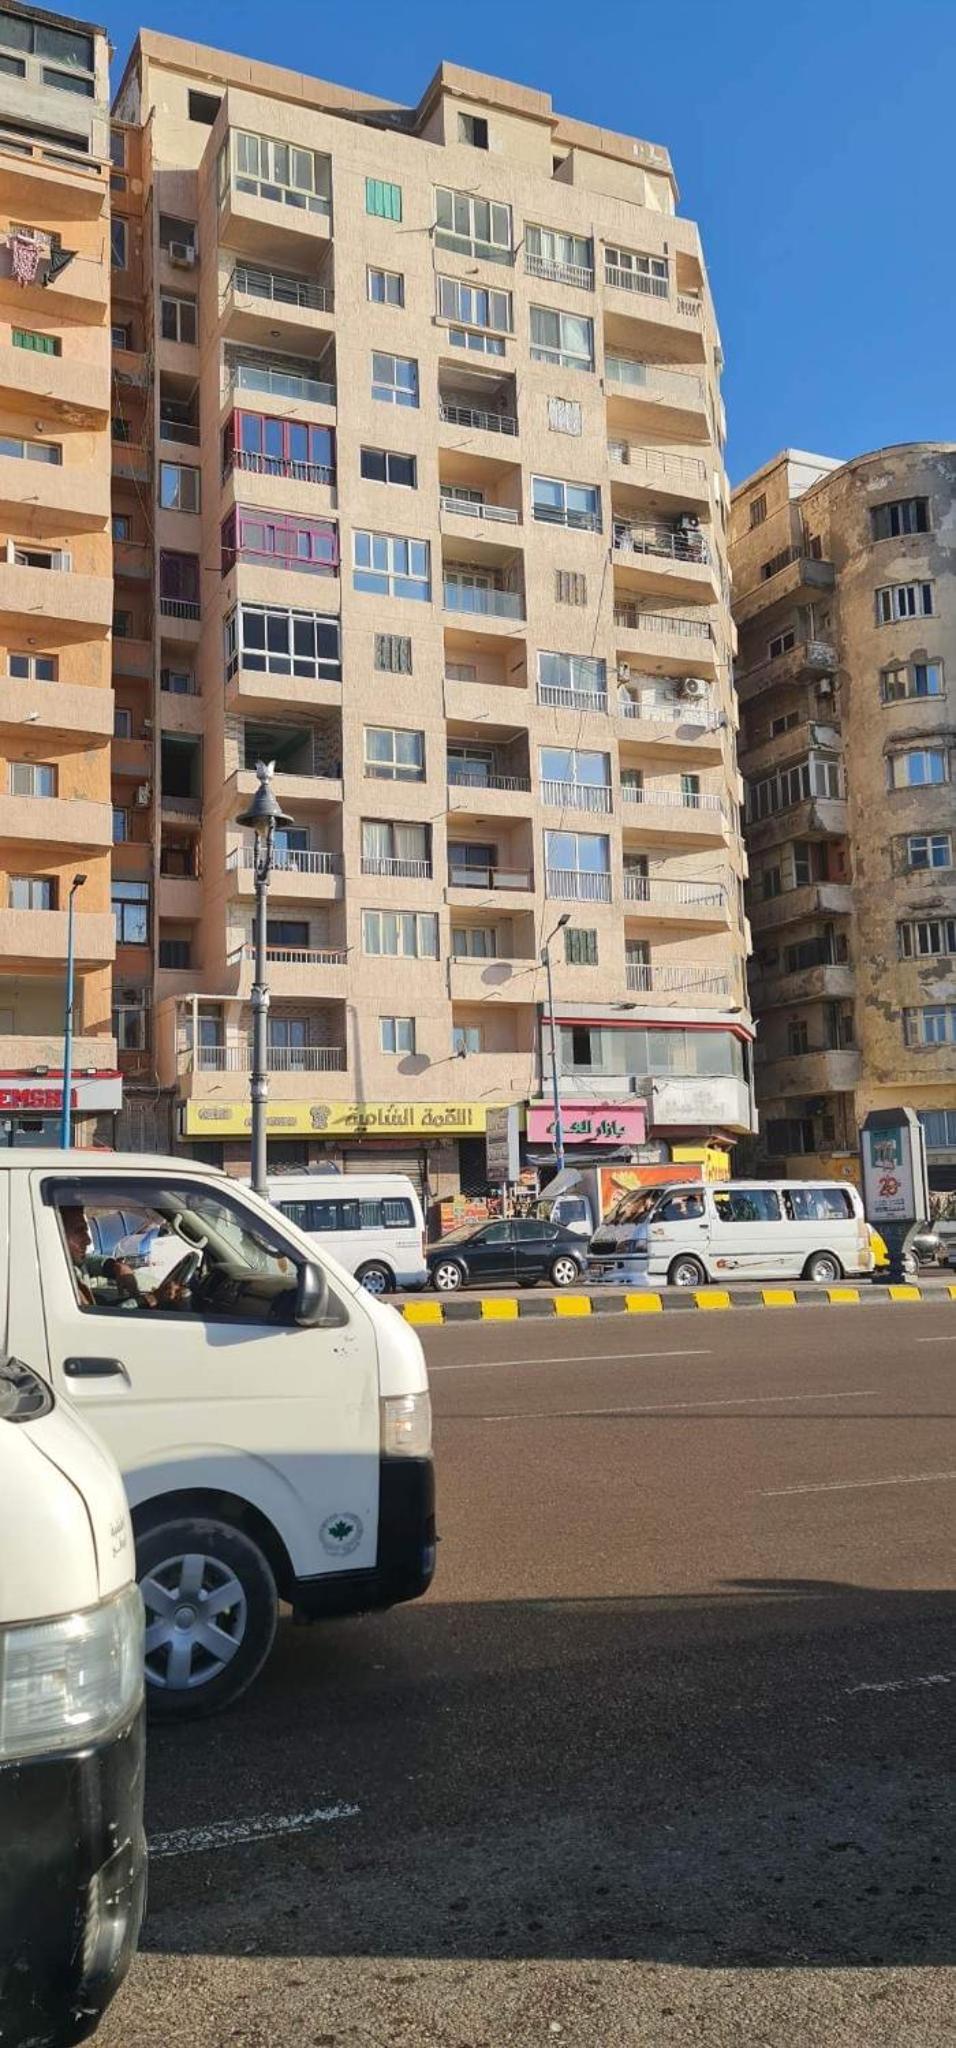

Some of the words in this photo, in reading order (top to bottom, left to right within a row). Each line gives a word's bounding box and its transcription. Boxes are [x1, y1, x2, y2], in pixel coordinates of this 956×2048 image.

[344, 1104, 414, 1131] الشامية
[421, 1107, 472, 1127] اللقمة
[596, 1119, 625, 1138] بازار
